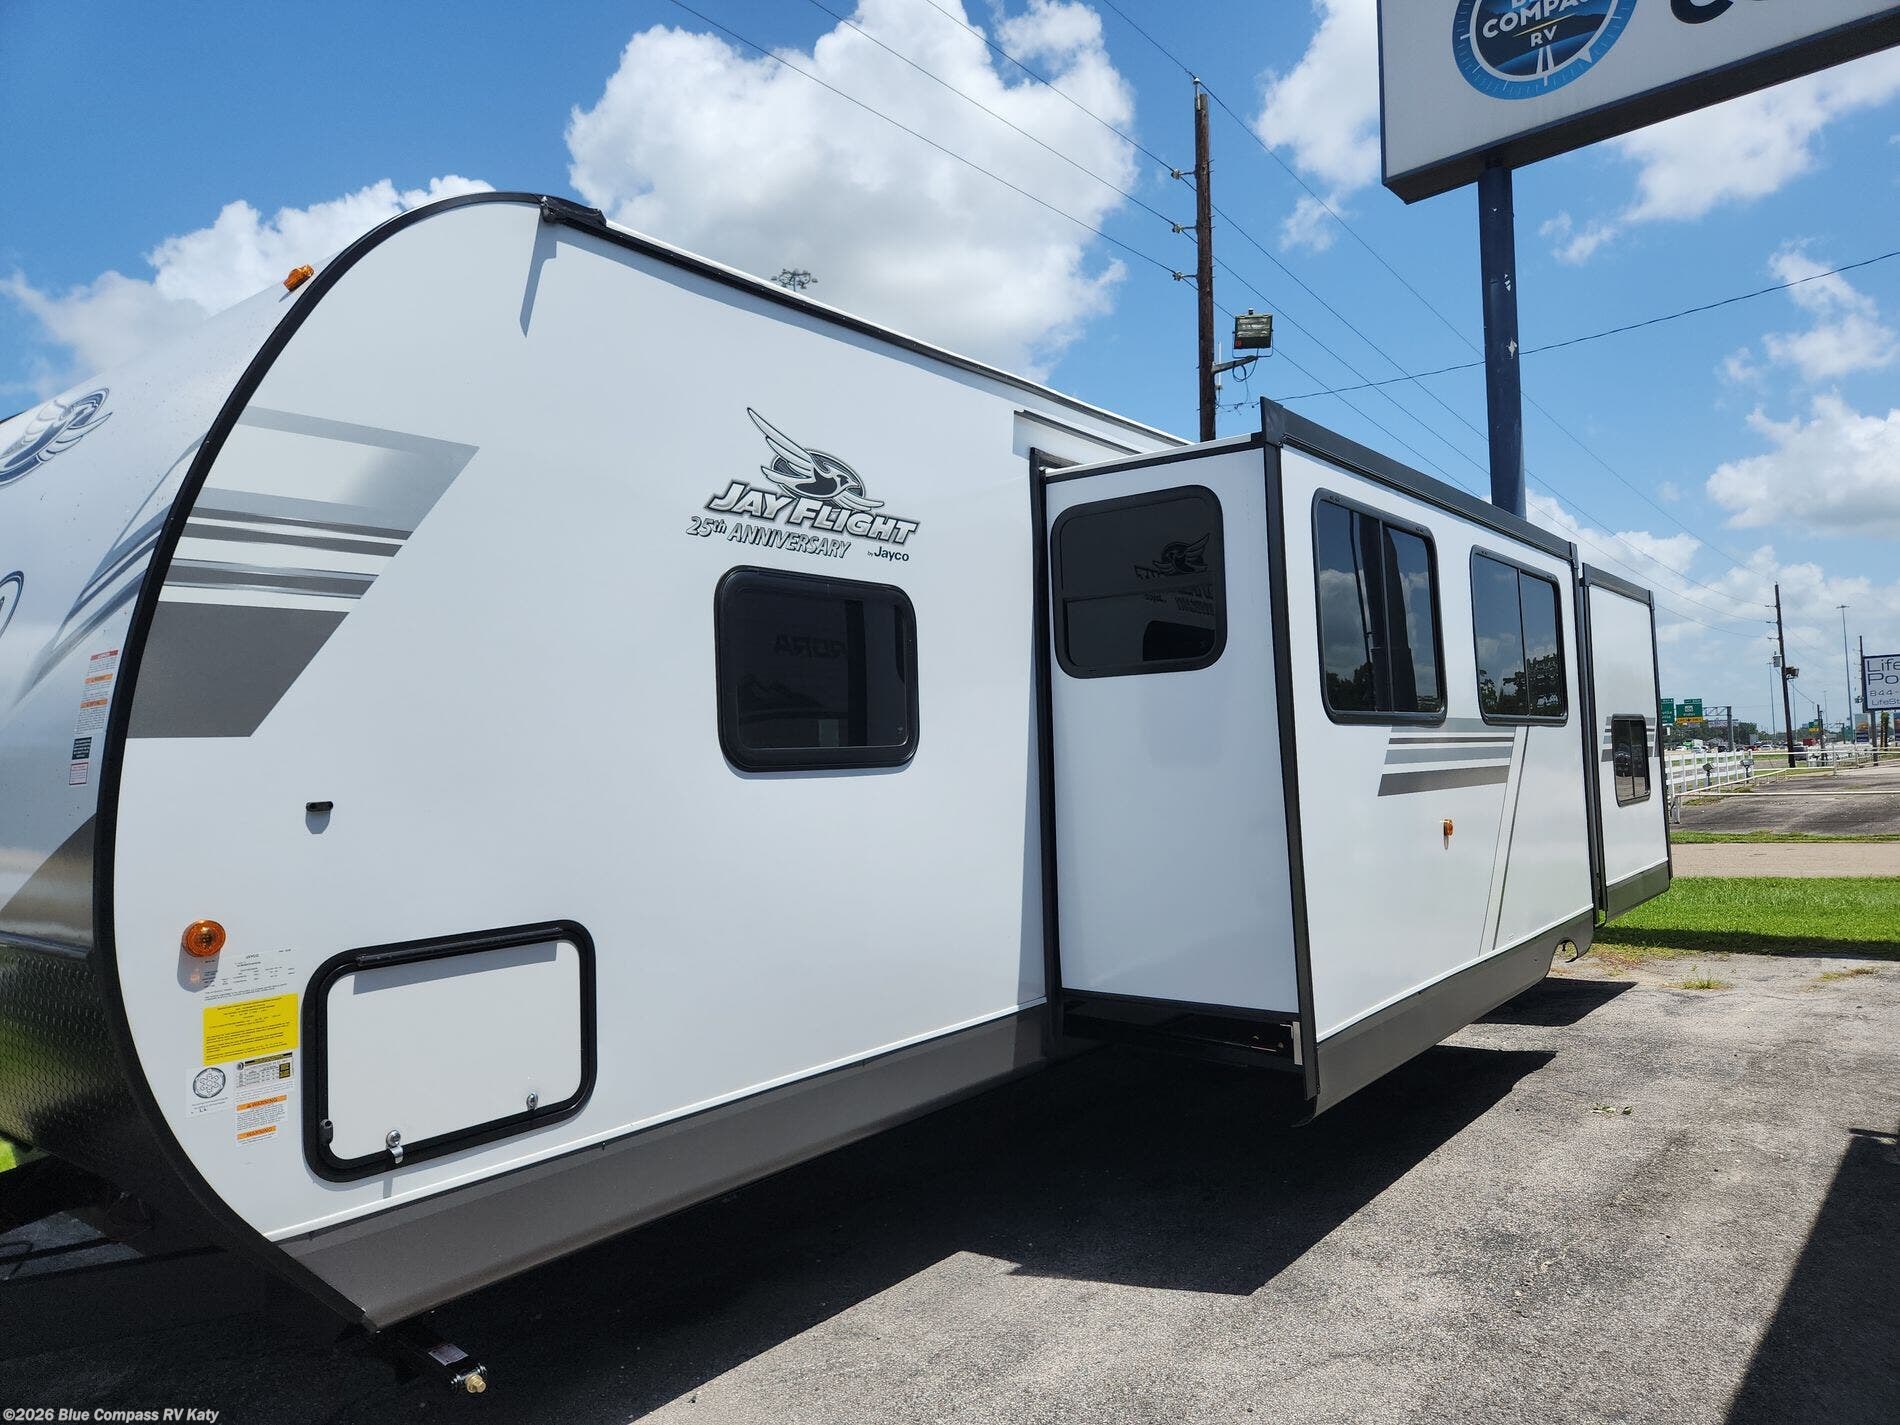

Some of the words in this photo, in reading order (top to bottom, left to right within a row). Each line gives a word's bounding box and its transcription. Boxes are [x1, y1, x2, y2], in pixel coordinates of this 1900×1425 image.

[1530, 25, 1557, 47] RV
[705, 480, 795, 521] JAY
[787, 497, 921, 546] FLIGHT
[686, 516, 728, 538] 25th
[727, 523, 852, 559] ANNIVERSARY
[874, 546, 909, 563] Jayco
